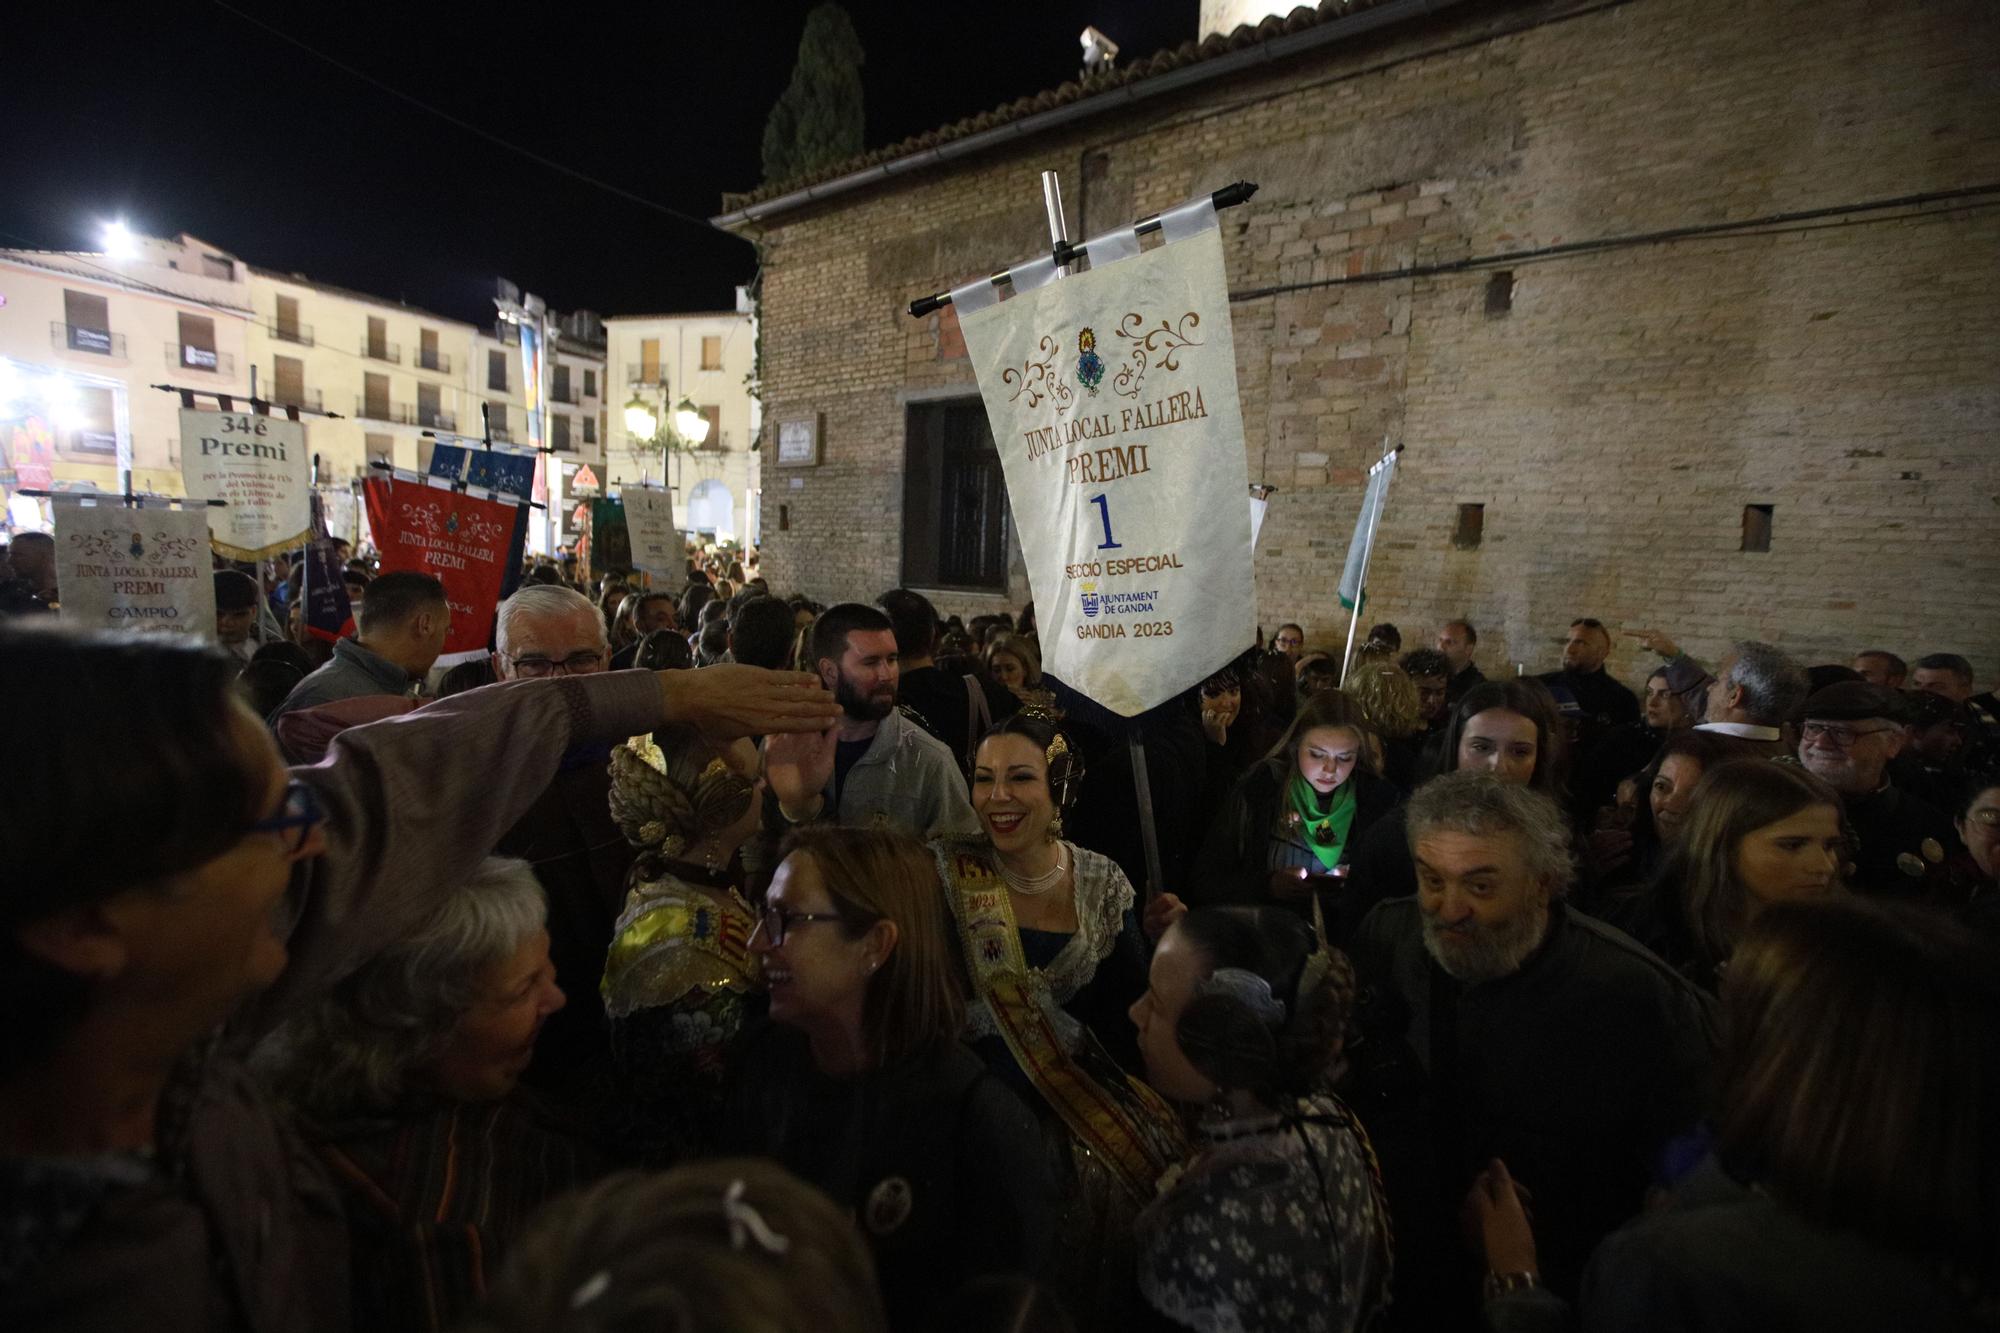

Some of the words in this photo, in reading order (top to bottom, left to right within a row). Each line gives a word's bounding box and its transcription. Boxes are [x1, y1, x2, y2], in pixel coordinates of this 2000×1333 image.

[1023, 426, 1063, 461] JUNTA
[1064, 414, 1116, 445] LOCAL
[1120, 385, 1208, 433] FALLERA
[200, 437, 287, 461] Premi
[1066, 444, 1151, 484] PREMI
[1090, 493, 1122, 550] 1
[400, 531, 426, 547] JUNTA
[428, 539, 455, 551] LOCAL
[457, 544, 494, 562] FALLERA
[424, 551, 465, 570] PREMI
[1065, 558, 1102, 580] SECCIÓ
[1106, 553, 1184, 576] ESPECIAL
[77, 564, 110, 578] JUNTA
[114, 566, 147, 577] LOCAL
[152, 566, 198, 578] FALLERA
[113, 581, 165, 595] PREMI
[1100, 590, 1159, 605] AJUNTAMENT
[108, 606, 178, 619] CAMPIÓ
[1104, 605, 1116, 615] DE
[1118, 602, 1154, 614] GANDIA
[1076, 623, 1126, 640] GANDIA
[1133, 620, 1174, 638] 2023
[968, 894, 996, 911] 2023
